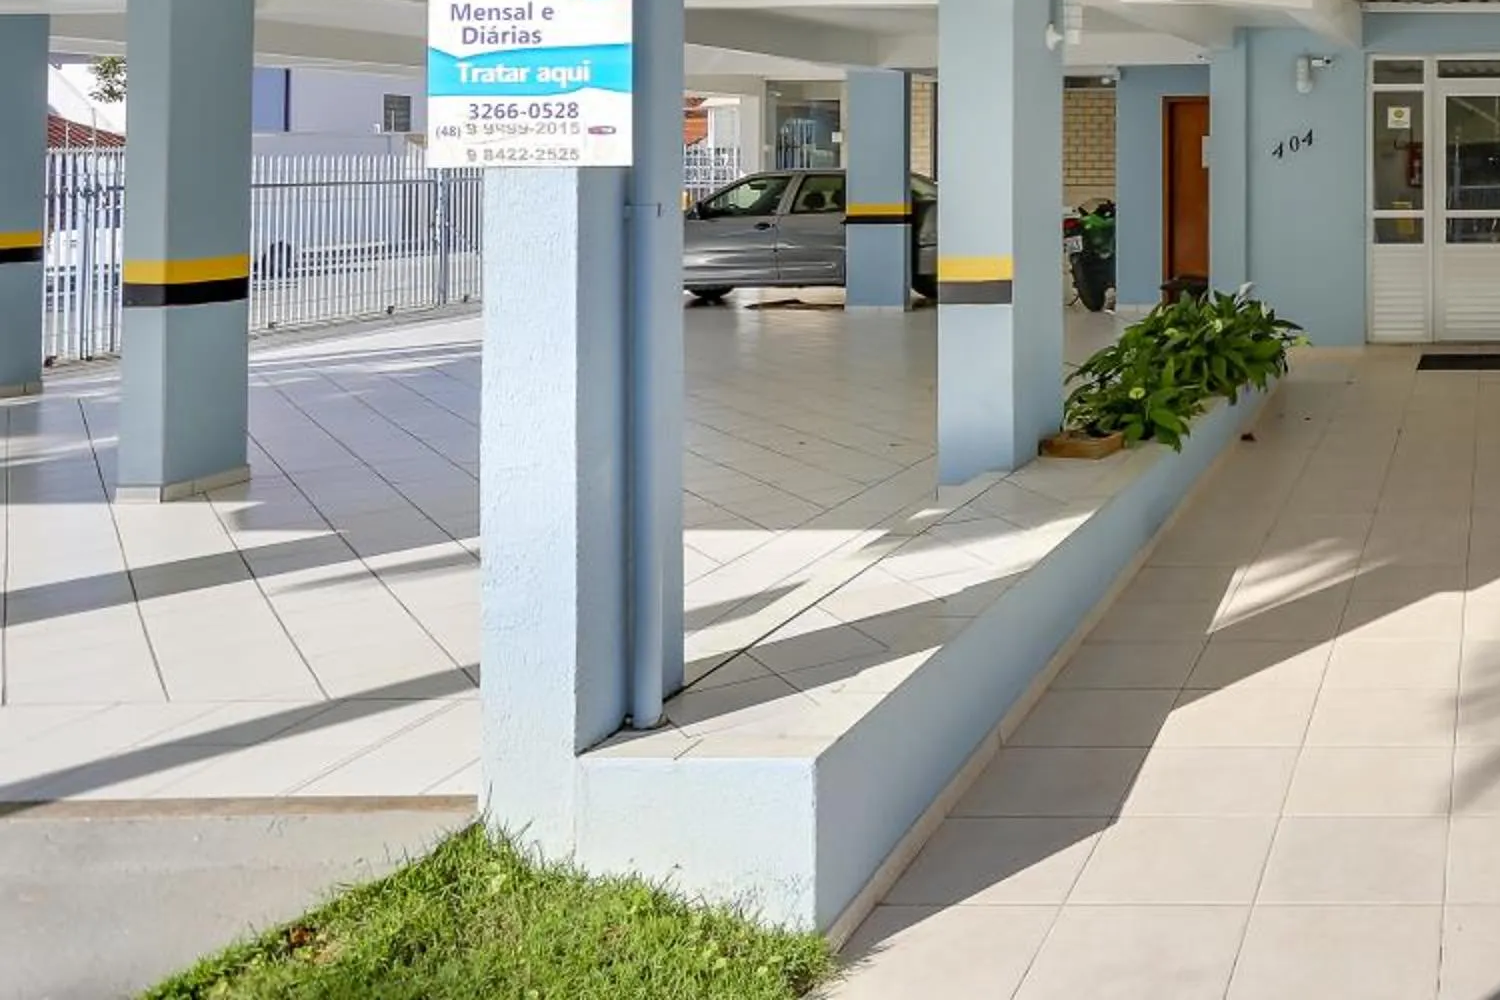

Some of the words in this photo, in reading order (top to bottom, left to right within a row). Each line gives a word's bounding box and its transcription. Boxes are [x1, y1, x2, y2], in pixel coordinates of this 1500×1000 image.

[451, 1, 533, 21] Mensal
[542, 6, 554, 20] e
[461, 25, 543, 45] Diárias
[456, 63, 530, 84] Tratar
[536, 60, 591, 89] aqui
[469, 102, 579, 119] 3266-0528
[435, 126, 461, 139] (48)
